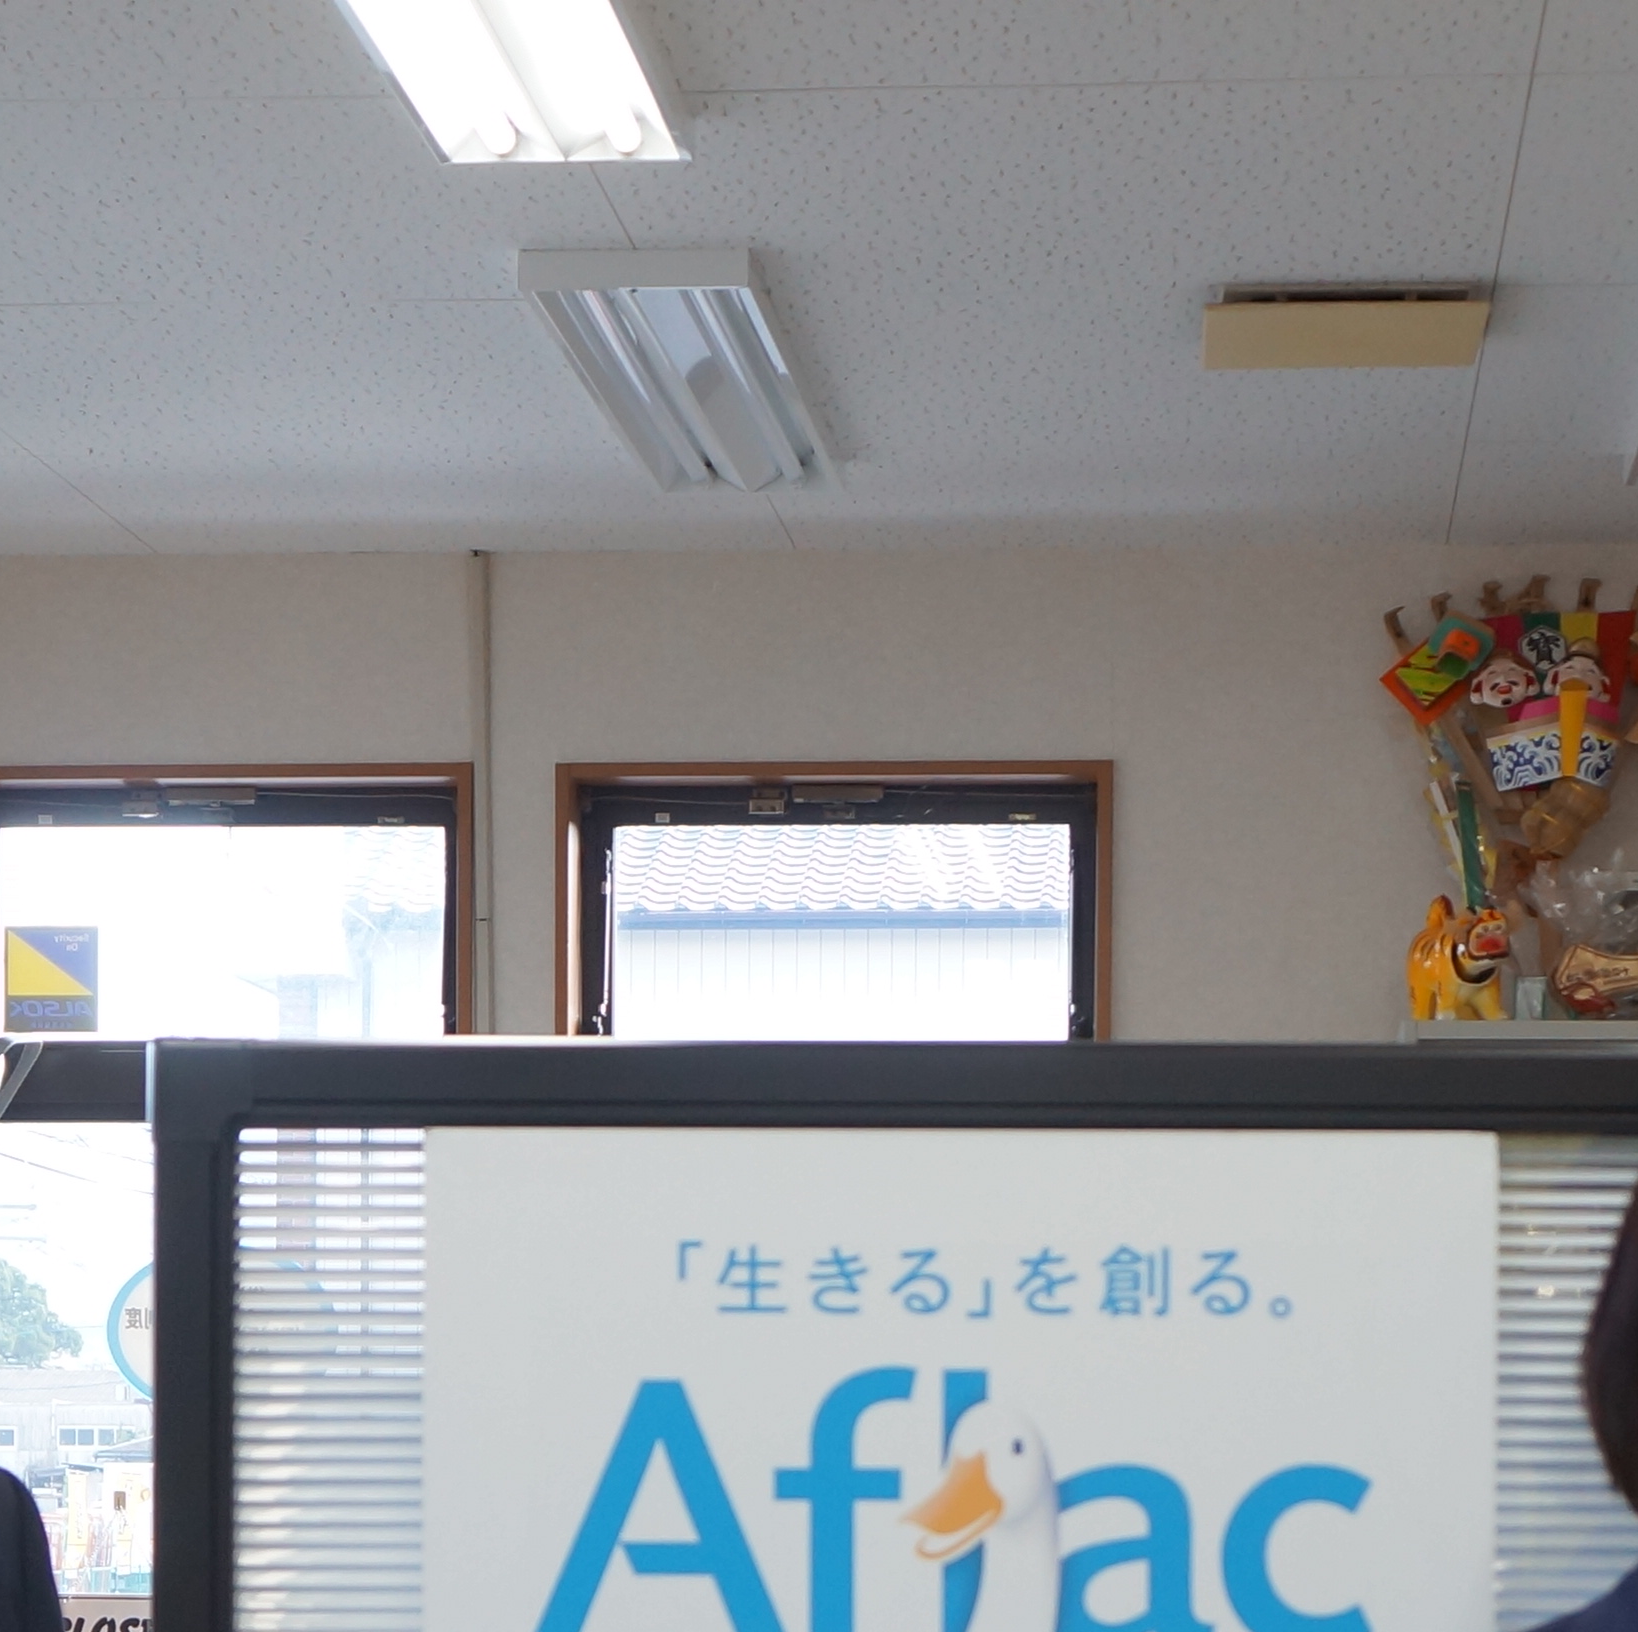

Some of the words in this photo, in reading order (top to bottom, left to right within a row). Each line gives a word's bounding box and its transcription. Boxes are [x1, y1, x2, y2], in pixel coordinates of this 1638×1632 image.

[674, 1240, 1294, 1320] 「生きる」を創る。
